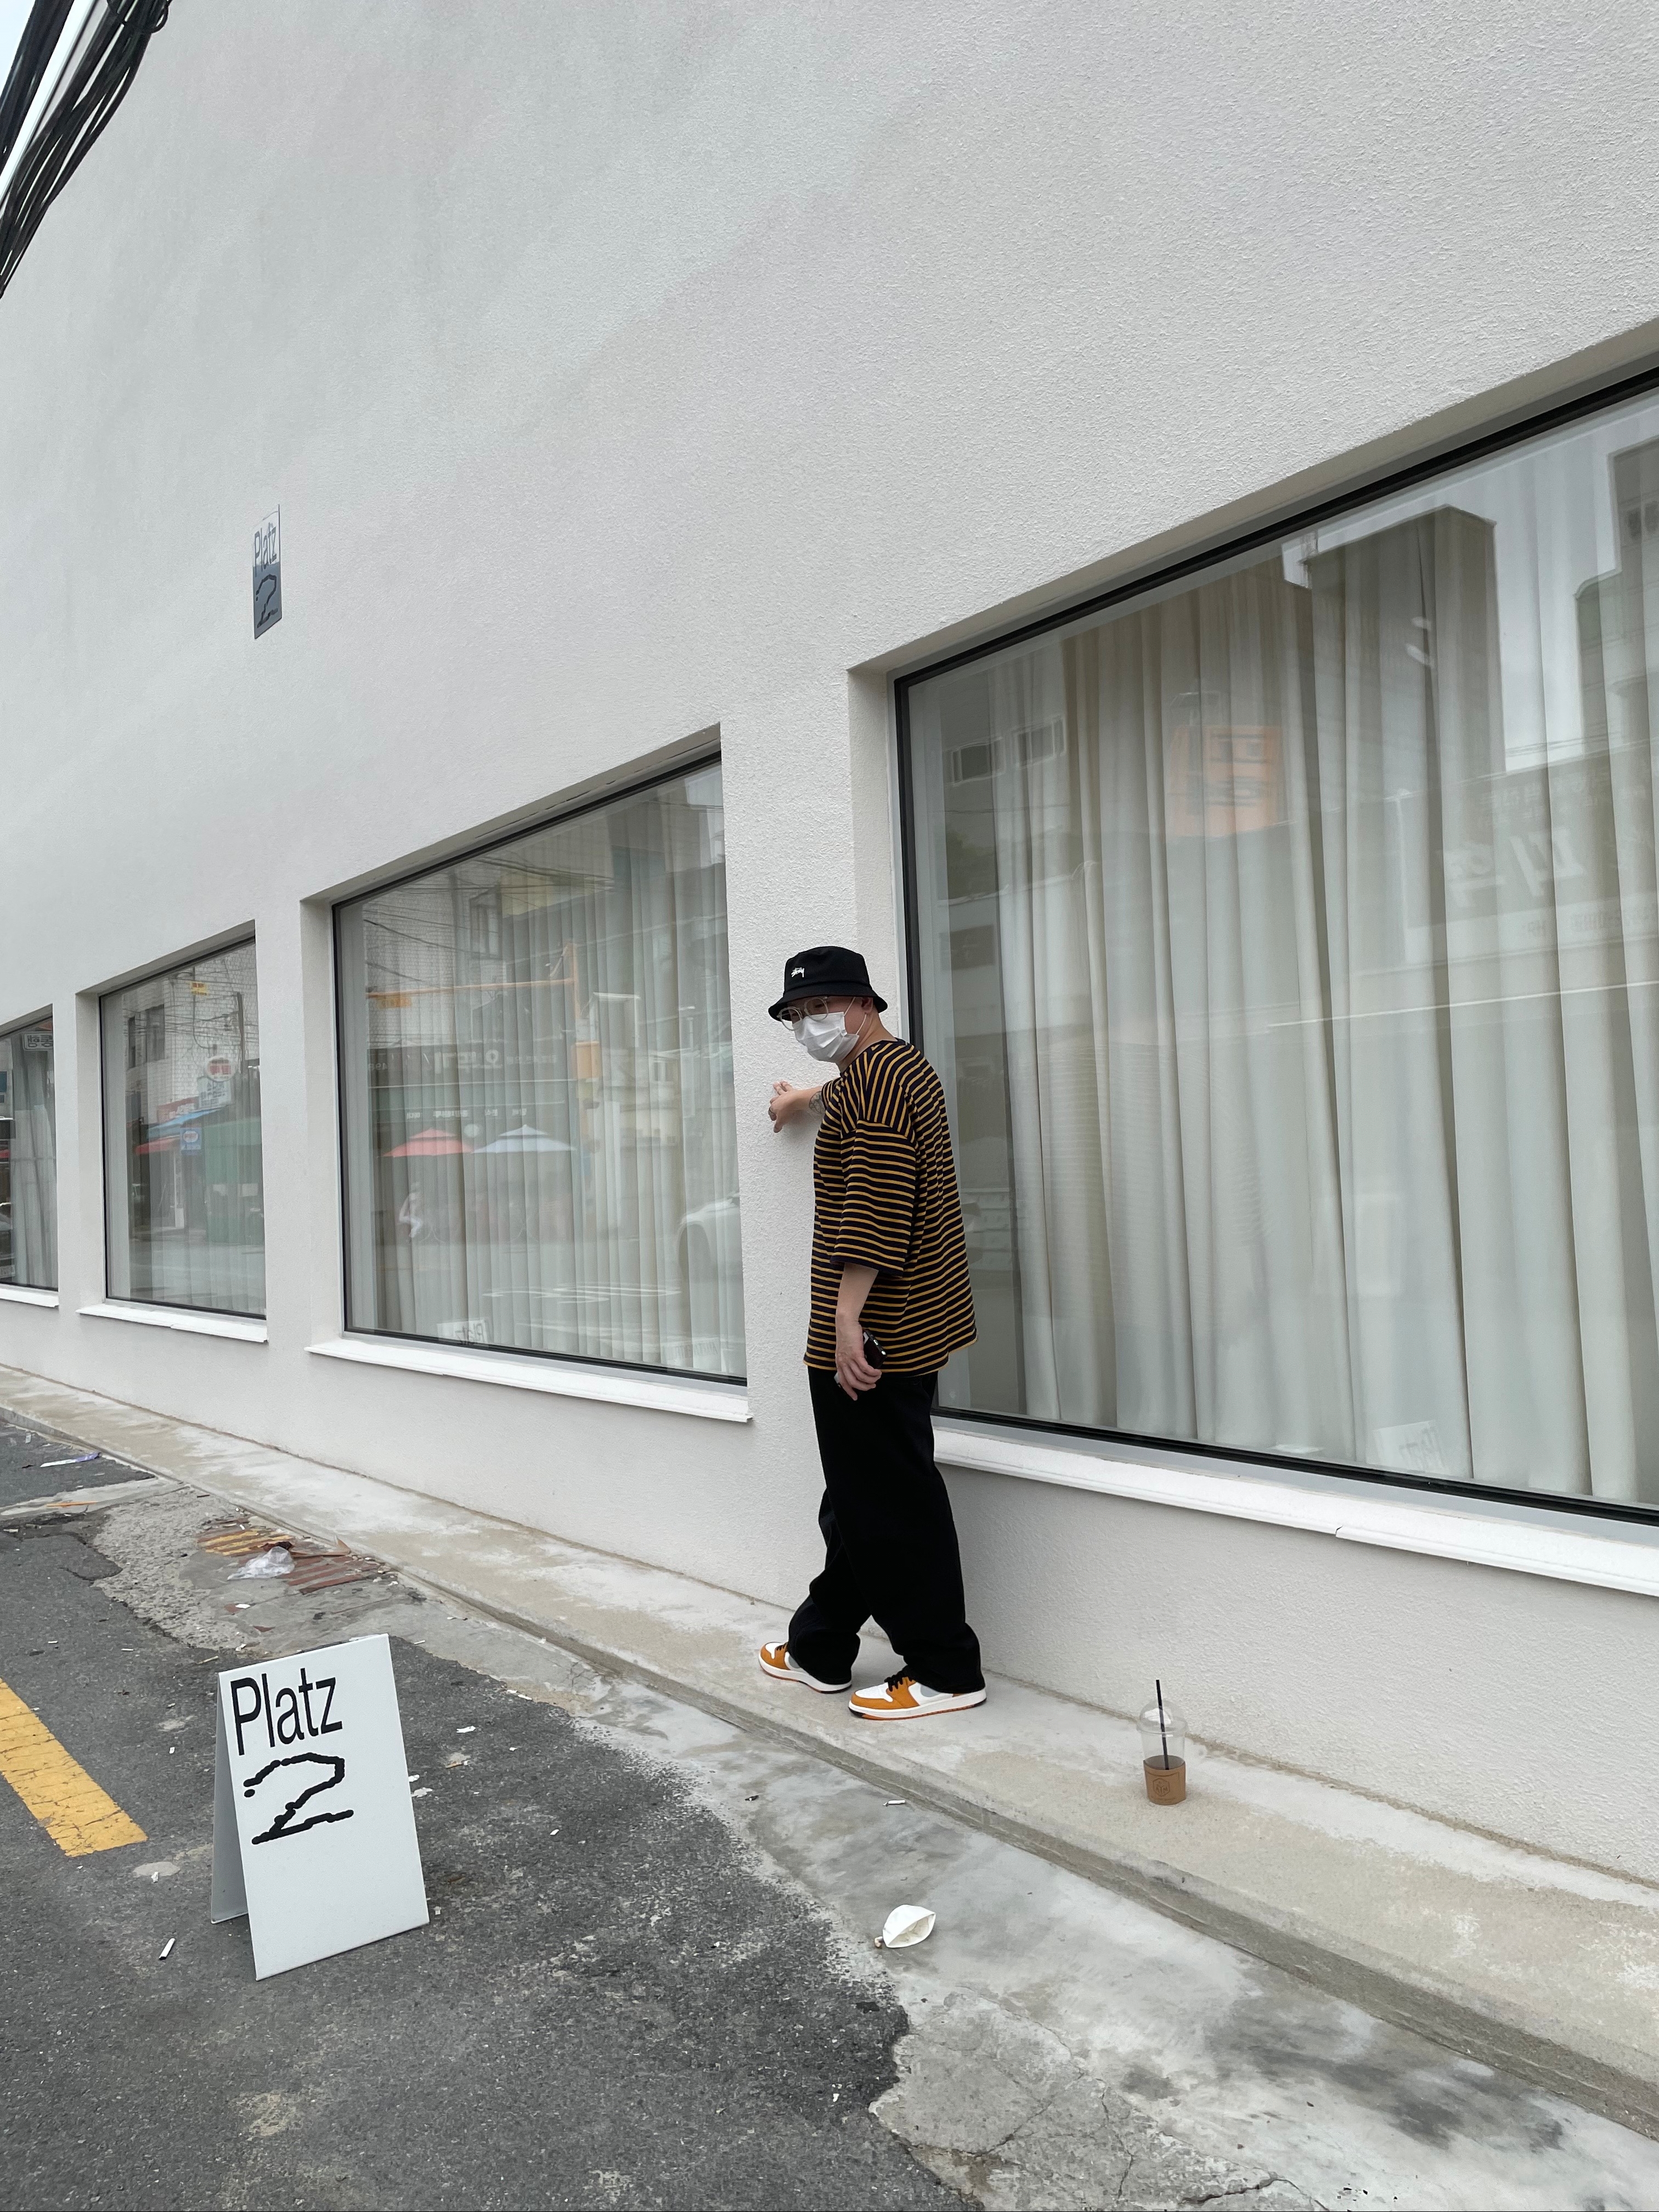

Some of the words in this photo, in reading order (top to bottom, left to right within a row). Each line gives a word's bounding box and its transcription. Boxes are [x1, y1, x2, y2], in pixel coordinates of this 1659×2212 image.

[255, 522, 277, 577] Platz
[230, 1667, 343, 1756] Platz
[243, 1752, 354, 1846] 2
